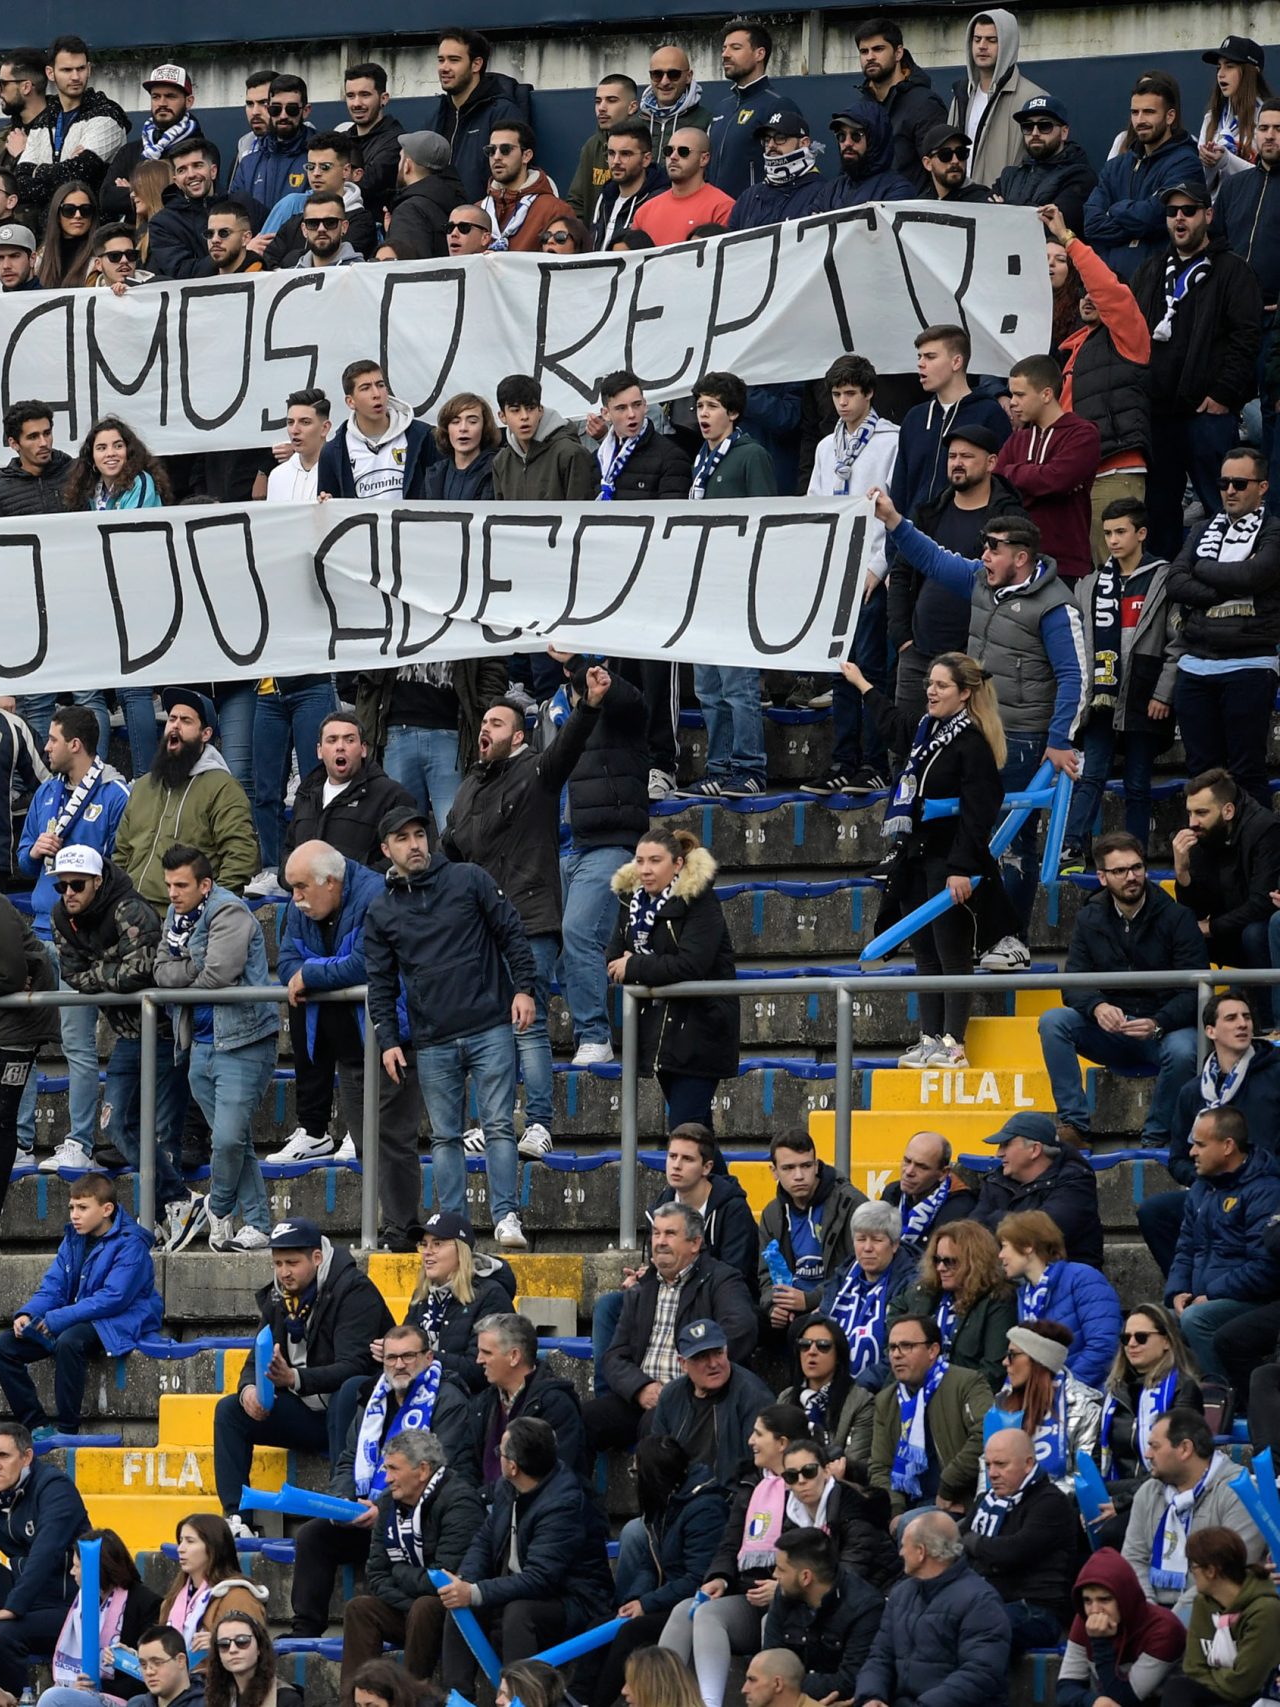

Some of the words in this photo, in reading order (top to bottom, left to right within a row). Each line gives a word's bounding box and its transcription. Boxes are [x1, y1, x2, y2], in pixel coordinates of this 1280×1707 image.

[1029, 99, 1047, 109] 1931
[98, 512, 271, 675] DO
[745, 829, 767, 844] 25
[837, 825, 859, 840] 26
[796, 915, 818, 930] 27
[920, 1071, 1000, 1105] FILA
[1014, 1074, 1034, 1107] L
[270, 1195, 292, 1210] 26
[158, 1374, 181, 1390] 30
[122, 1450, 204, 1489] FILA
